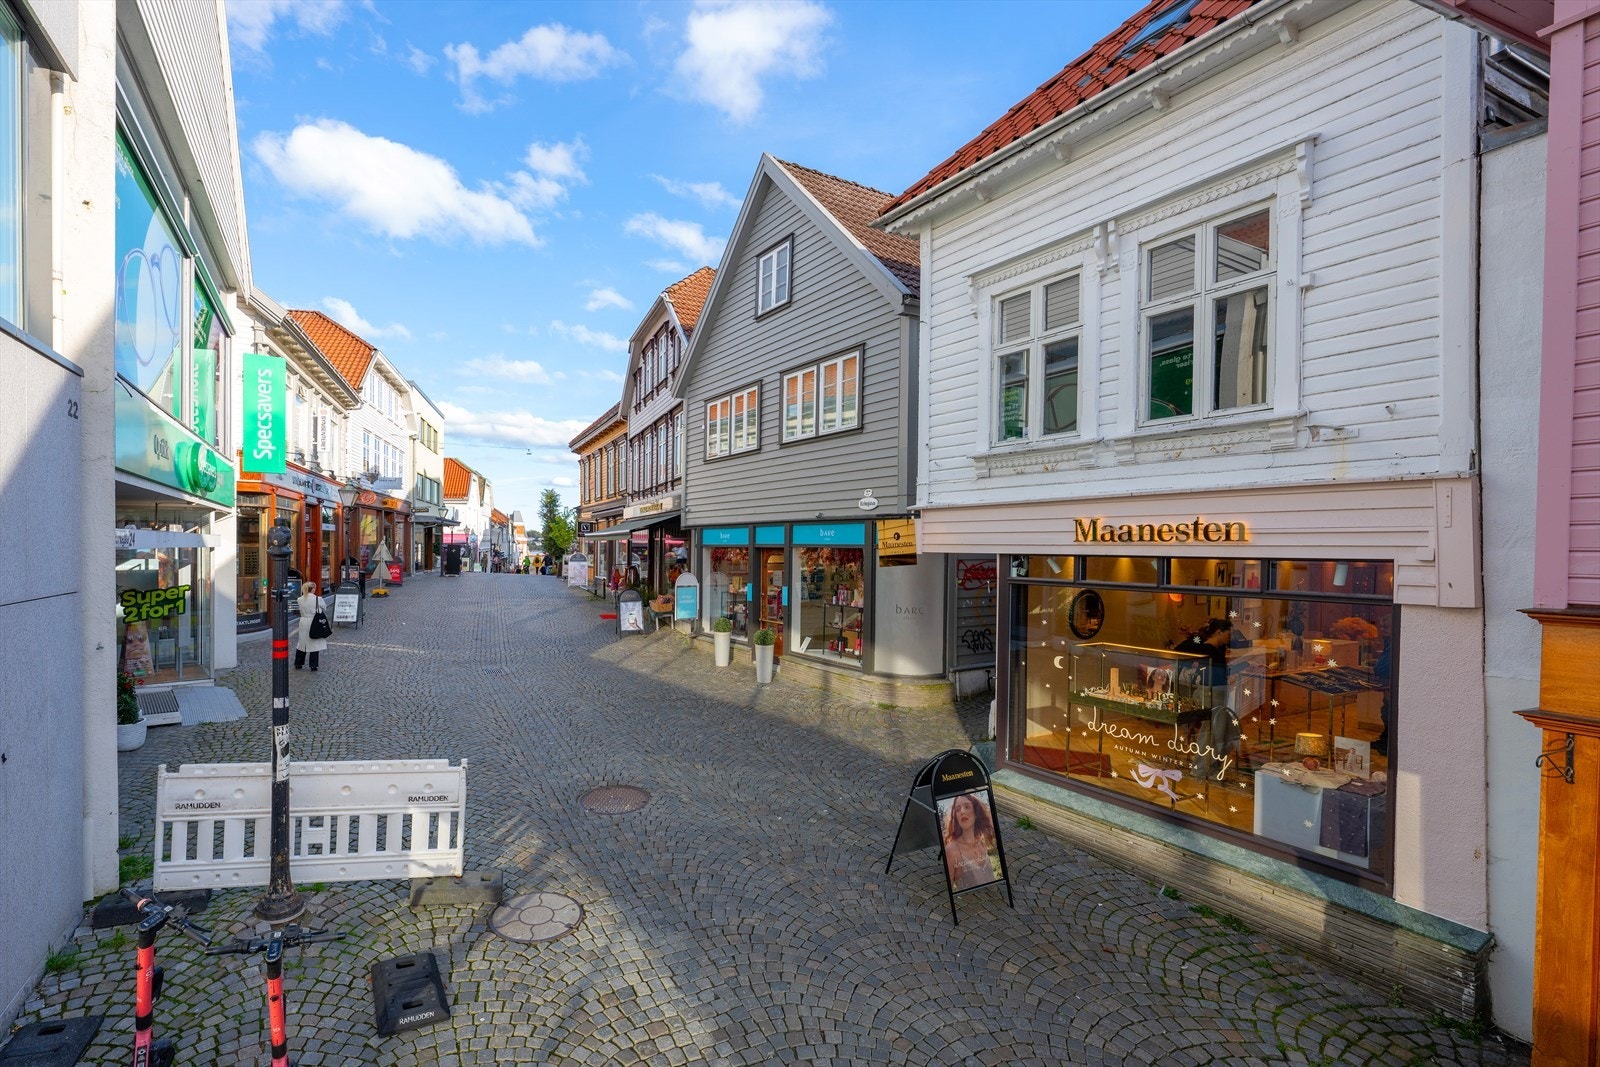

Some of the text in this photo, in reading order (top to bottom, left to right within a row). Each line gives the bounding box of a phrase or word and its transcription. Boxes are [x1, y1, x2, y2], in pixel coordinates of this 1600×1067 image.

[68, 399, 78, 419] 22
[253, 368, 276, 460] Specsavers
[1073, 516, 1248, 543] Maanesten
[881, 541, 913, 549] Maanesten
[121, 585, 190, 607] Super
[1087, 706, 1233, 781] dream diary
[1114, 744, 1147, 757] AUTUMN
[1151, 753, 1183, 766] WINTER
[942, 770, 973, 782] Maanesten
[175, 802, 221, 810] RAMUDDEN
[400, 1011, 435, 1025] RAMUDDEN
